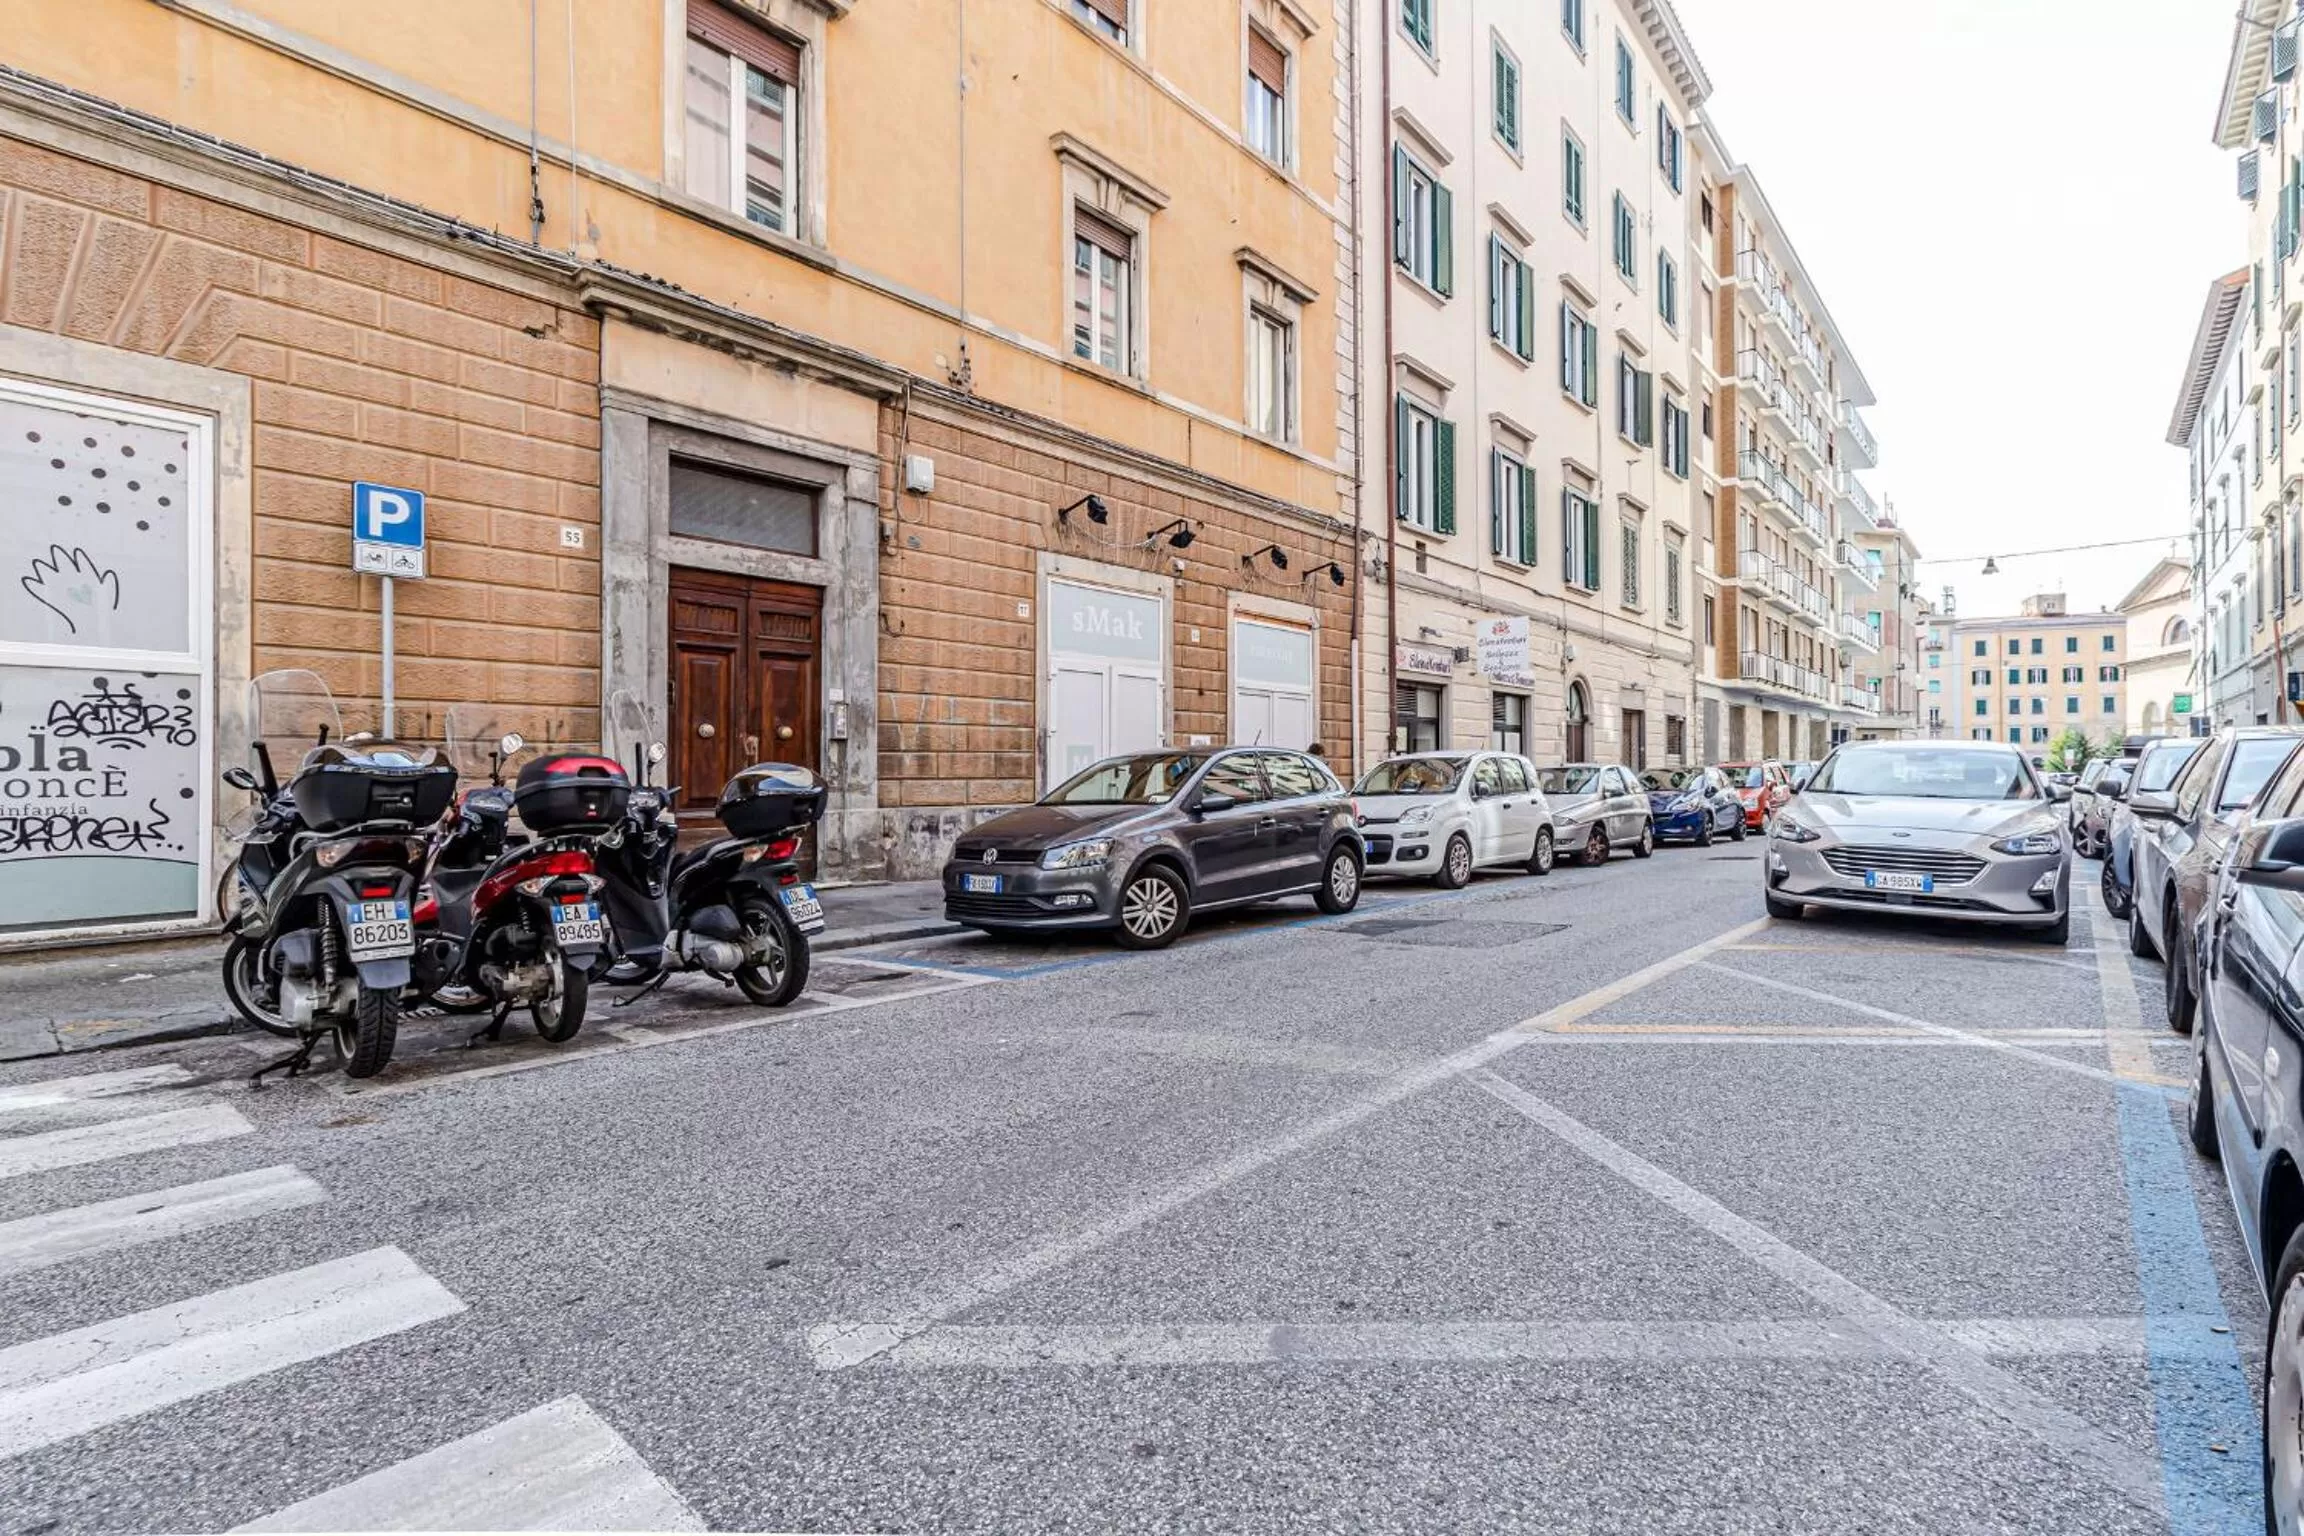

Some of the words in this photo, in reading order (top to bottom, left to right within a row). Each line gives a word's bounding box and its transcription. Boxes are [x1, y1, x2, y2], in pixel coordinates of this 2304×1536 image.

[368, 490, 410, 537] P
[566, 531, 580, 543] 55
[1072, 605, 1144, 640] sMak
[364, 903, 386, 920] EH
[563, 906, 581, 920] EA
[354, 923, 408, 944] 86203
